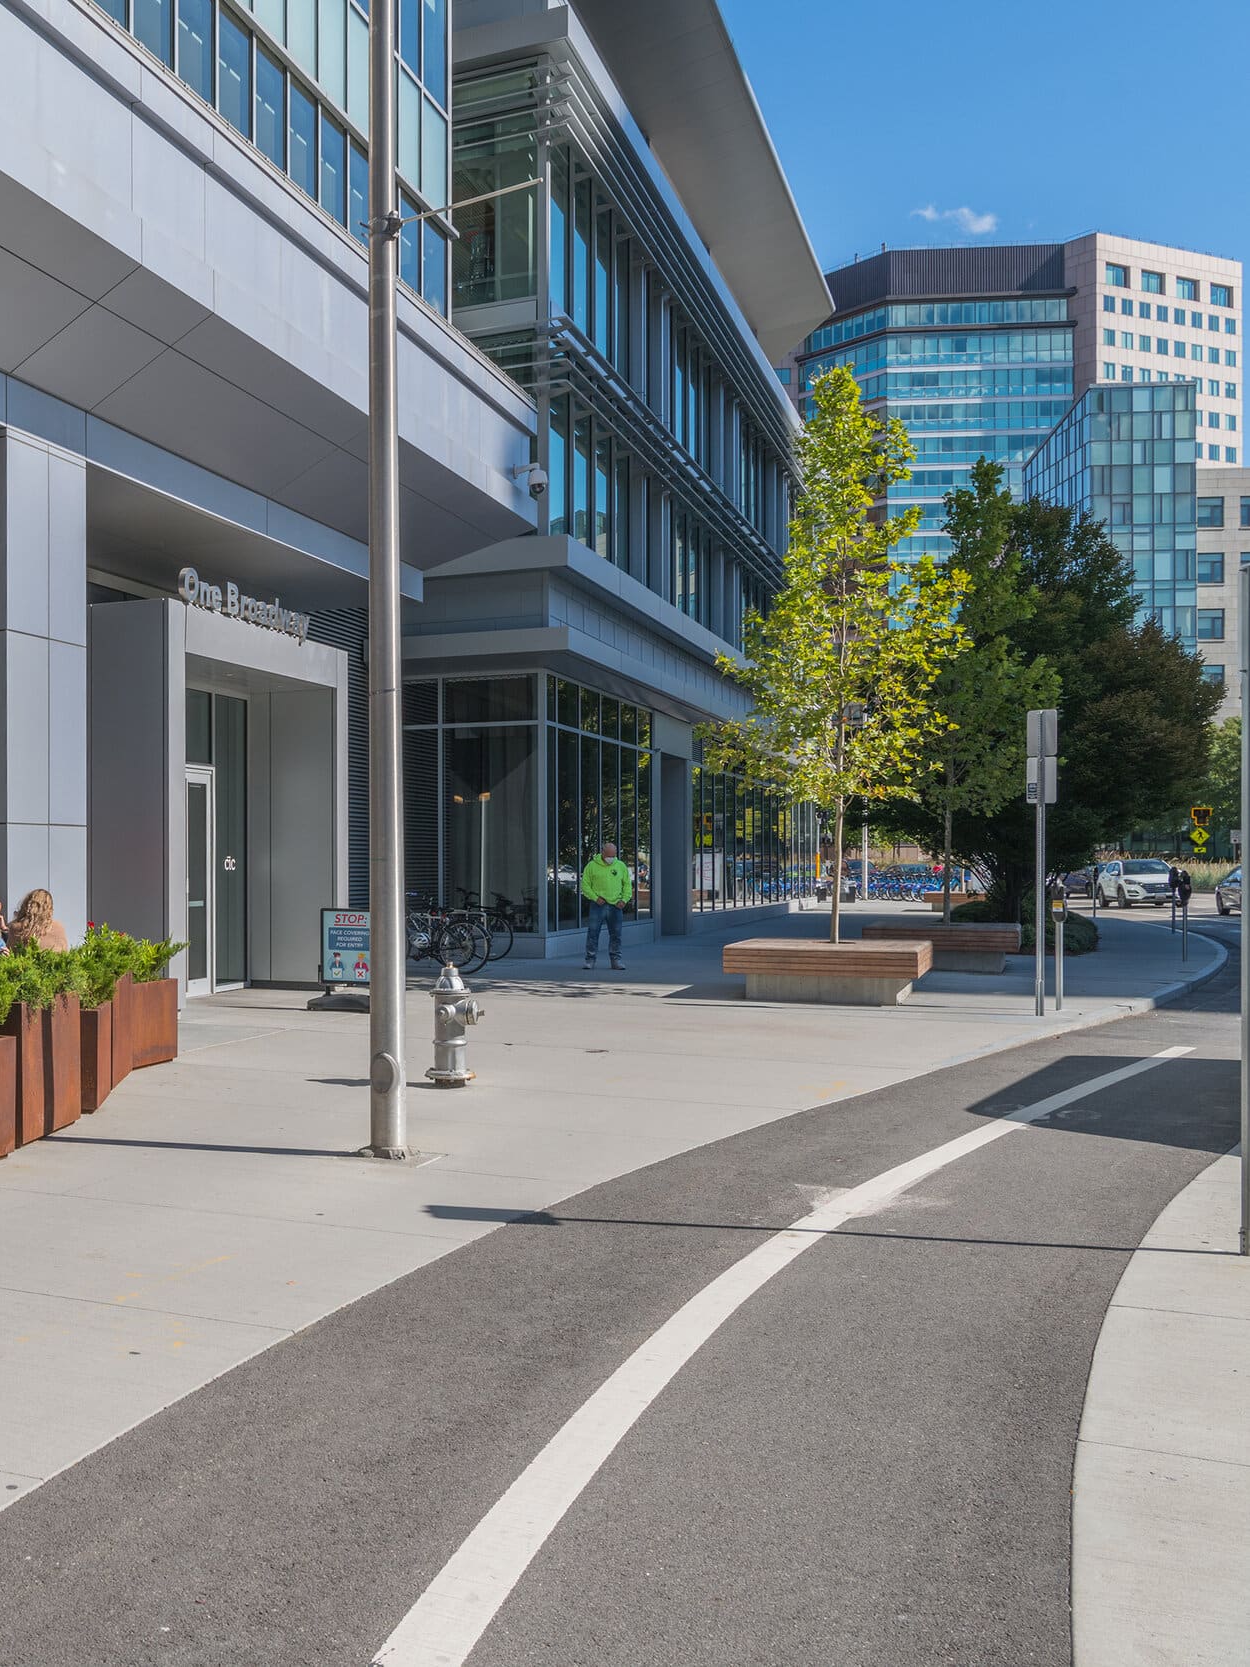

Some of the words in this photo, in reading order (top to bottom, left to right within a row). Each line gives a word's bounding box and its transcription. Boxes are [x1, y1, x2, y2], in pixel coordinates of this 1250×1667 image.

[178, 567, 223, 612] One
[225, 581, 310, 643] Broadway
[334, 913, 367, 924] STOP:
